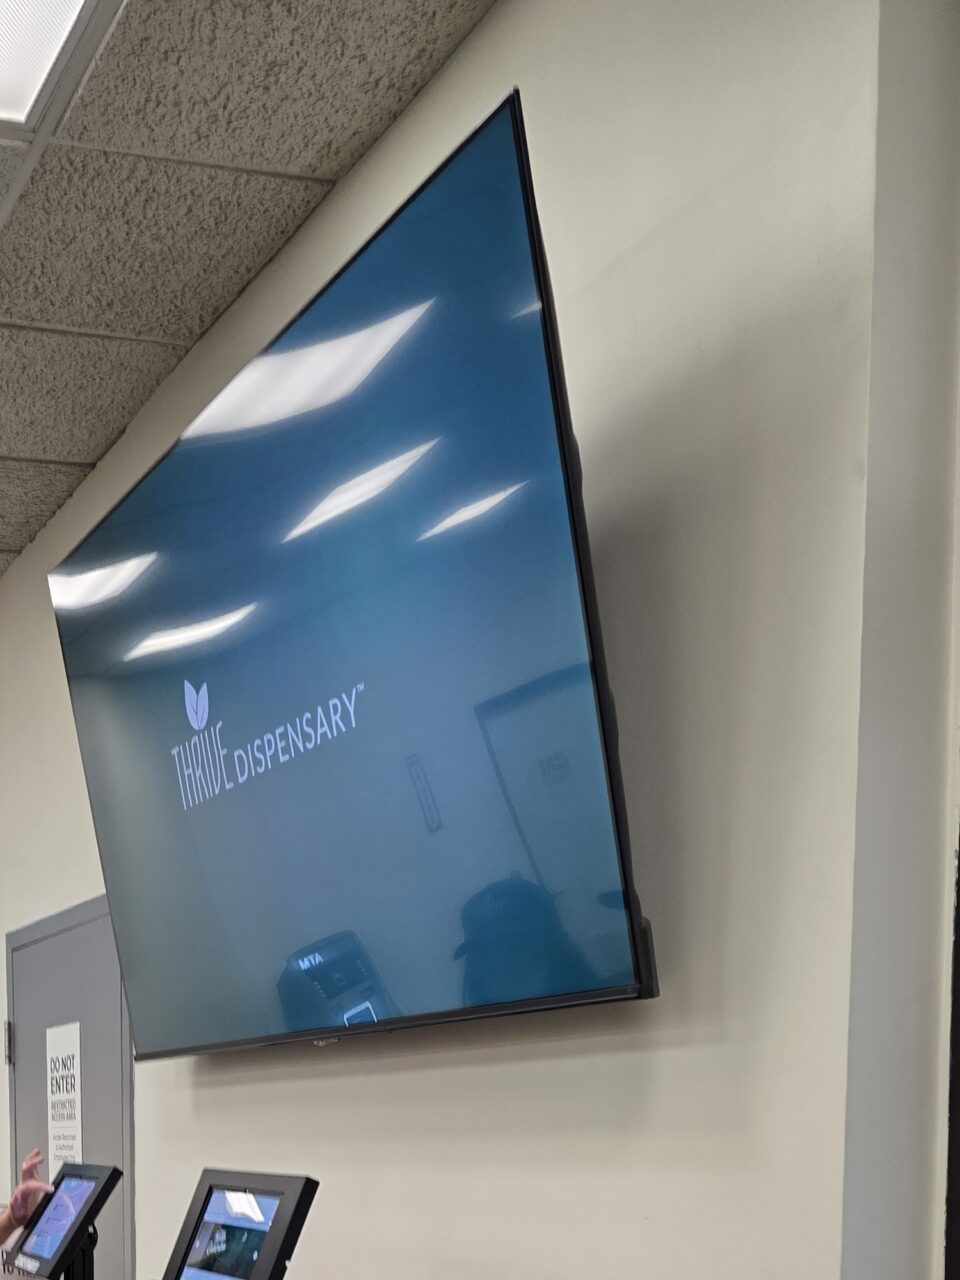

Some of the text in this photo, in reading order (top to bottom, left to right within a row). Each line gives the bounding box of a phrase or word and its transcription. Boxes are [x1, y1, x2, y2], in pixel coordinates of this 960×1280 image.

[171, 720, 233, 811] THRIVE
[50, 1054, 75, 1074] DO NOT
[51, 1074, 75, 1095] ENTER
